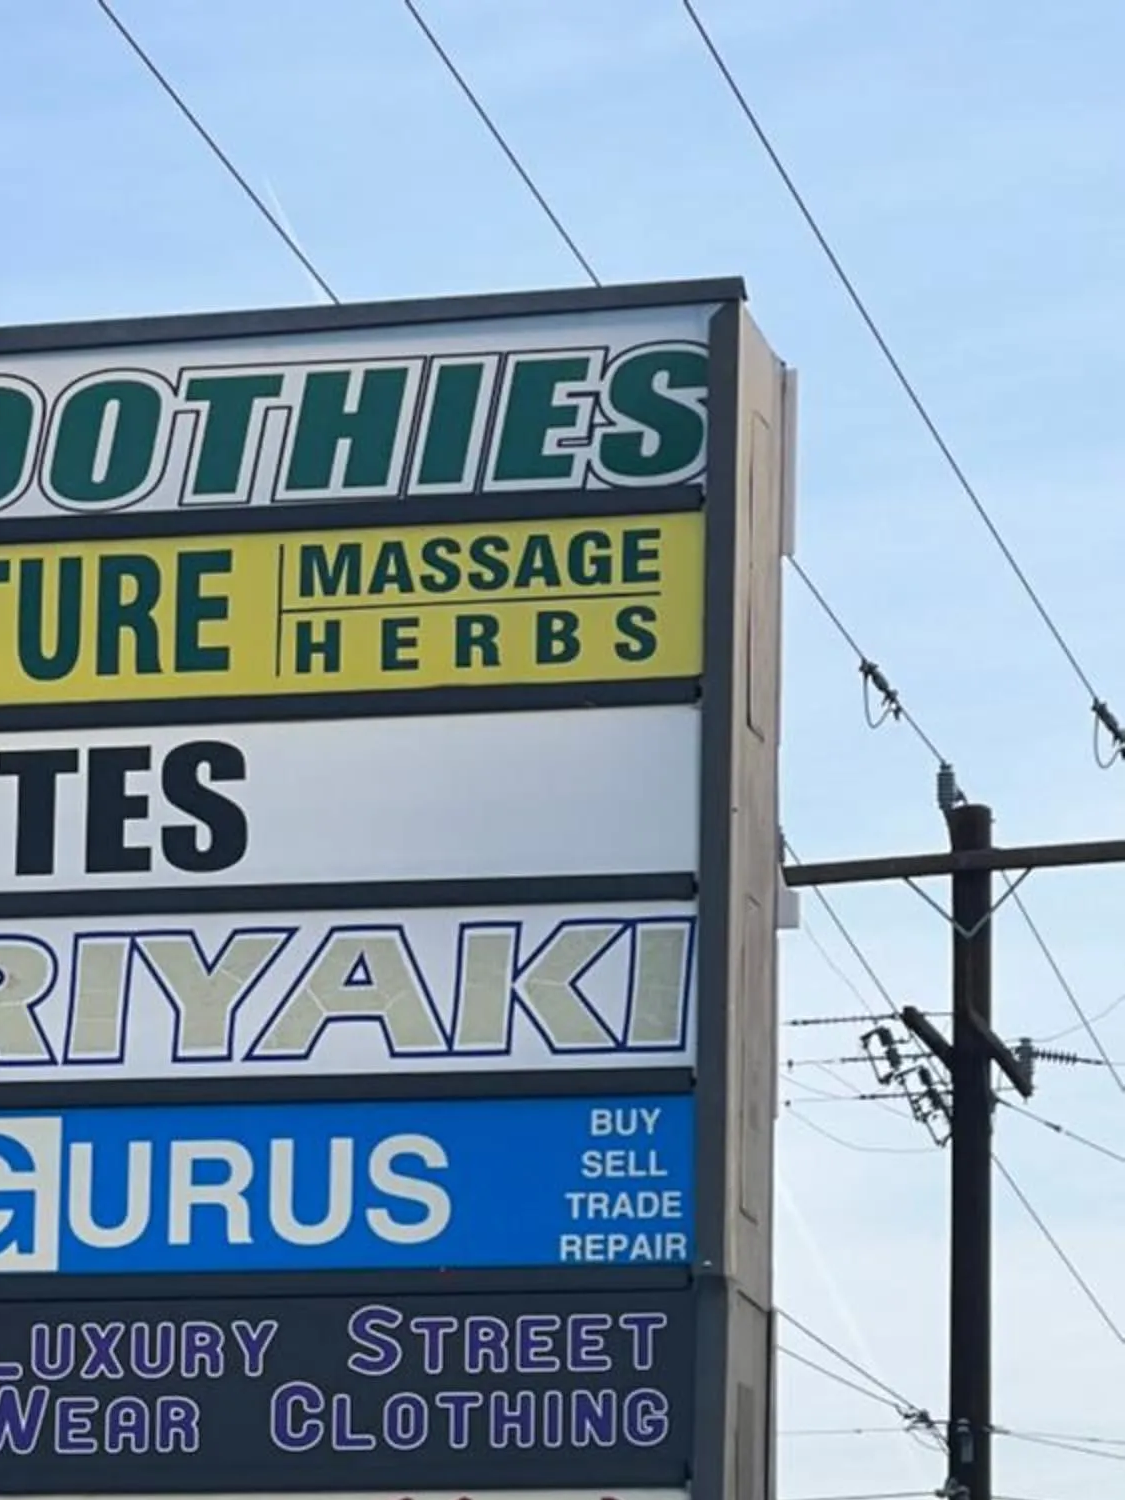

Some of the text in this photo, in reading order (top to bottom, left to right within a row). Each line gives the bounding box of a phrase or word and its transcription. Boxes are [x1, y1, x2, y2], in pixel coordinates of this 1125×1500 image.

[298, 528, 662, 598] MASSAGE
[294, 604, 658, 674] HERBS
[590, 1107, 662, 1137] BUY
[580, 1150, 669, 1179] SELL
[564, 1190, 683, 1221] TRADE
[559, 1231, 688, 1263] REPAIR
[346, 1305, 670, 1375] STREET
[270, 1380, 671, 1453] CLOTHING
